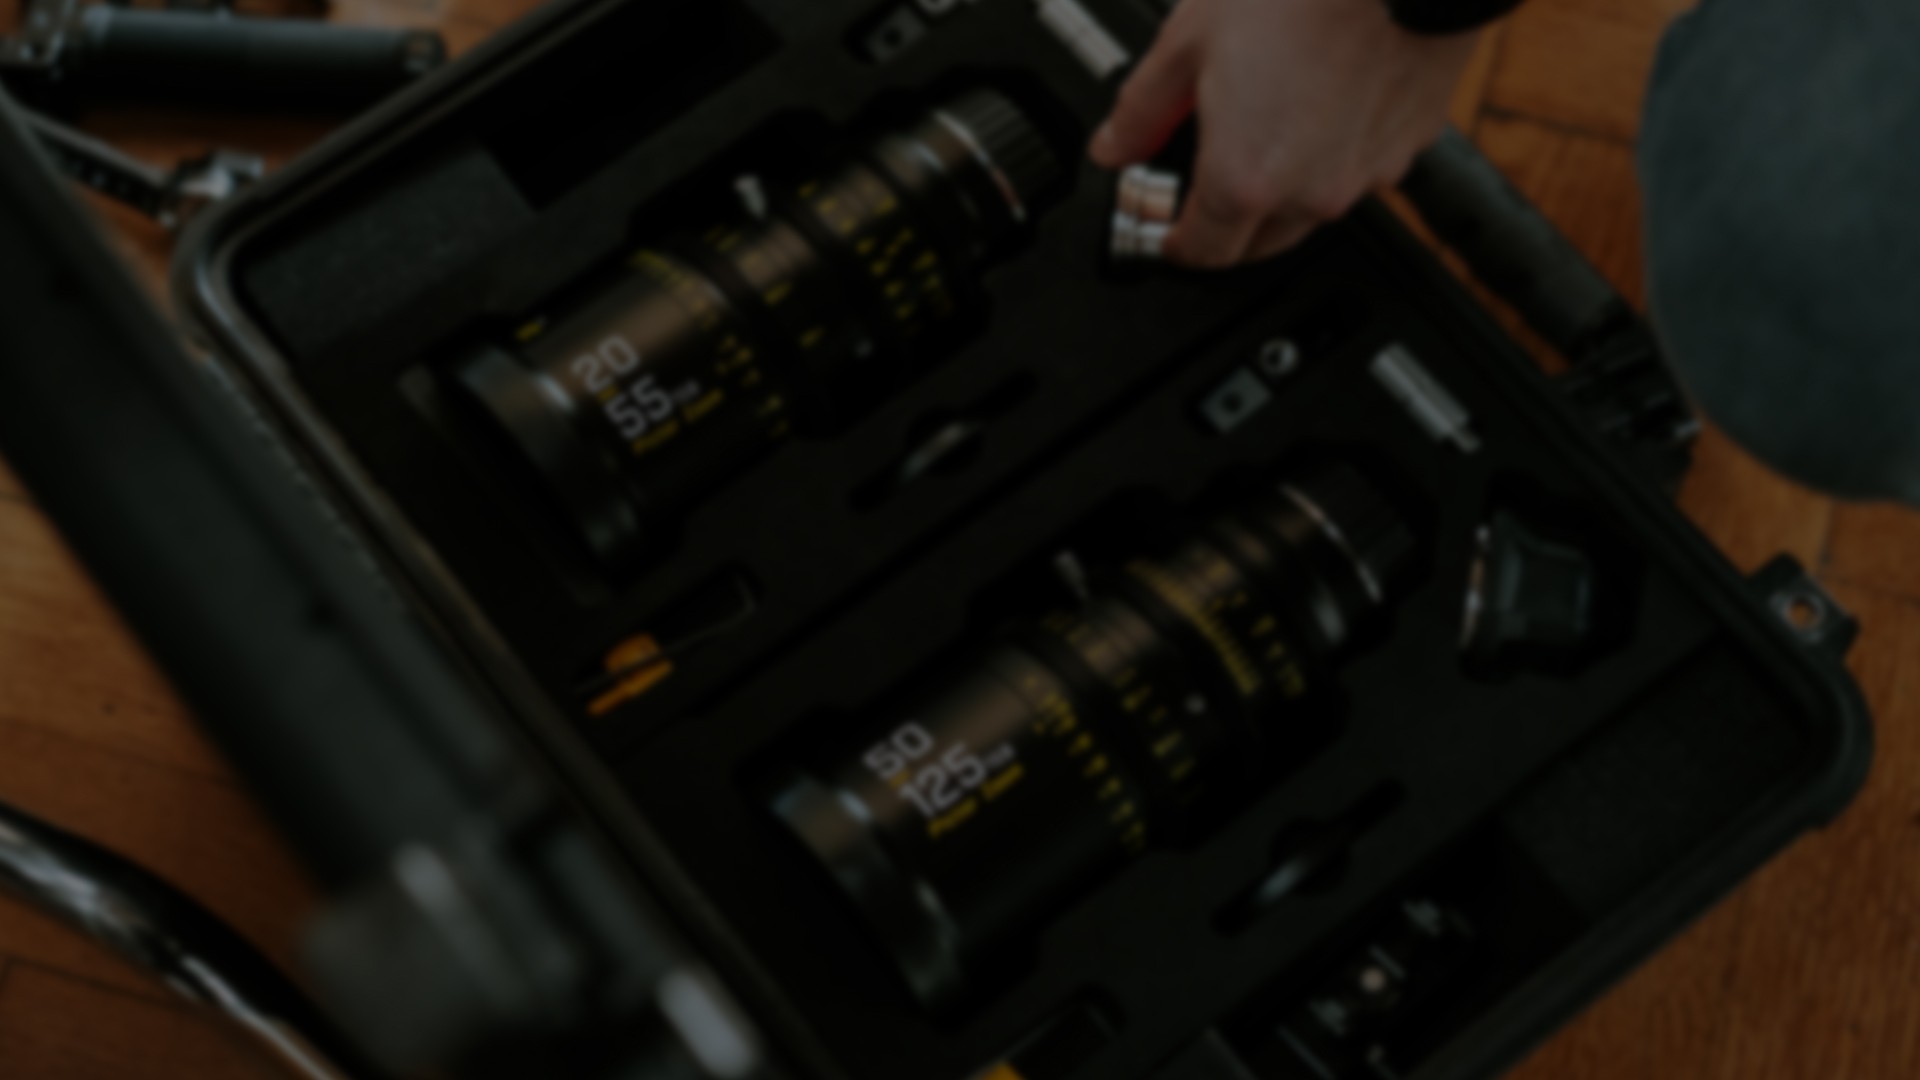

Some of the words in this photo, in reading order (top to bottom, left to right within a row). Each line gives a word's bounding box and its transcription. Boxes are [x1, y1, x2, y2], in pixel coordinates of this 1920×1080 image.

[570, 333, 641, 394] 20
[604, 374, 674, 440] 55
[862, 720, 934, 780] 50
[900, 740, 987, 819] 125
